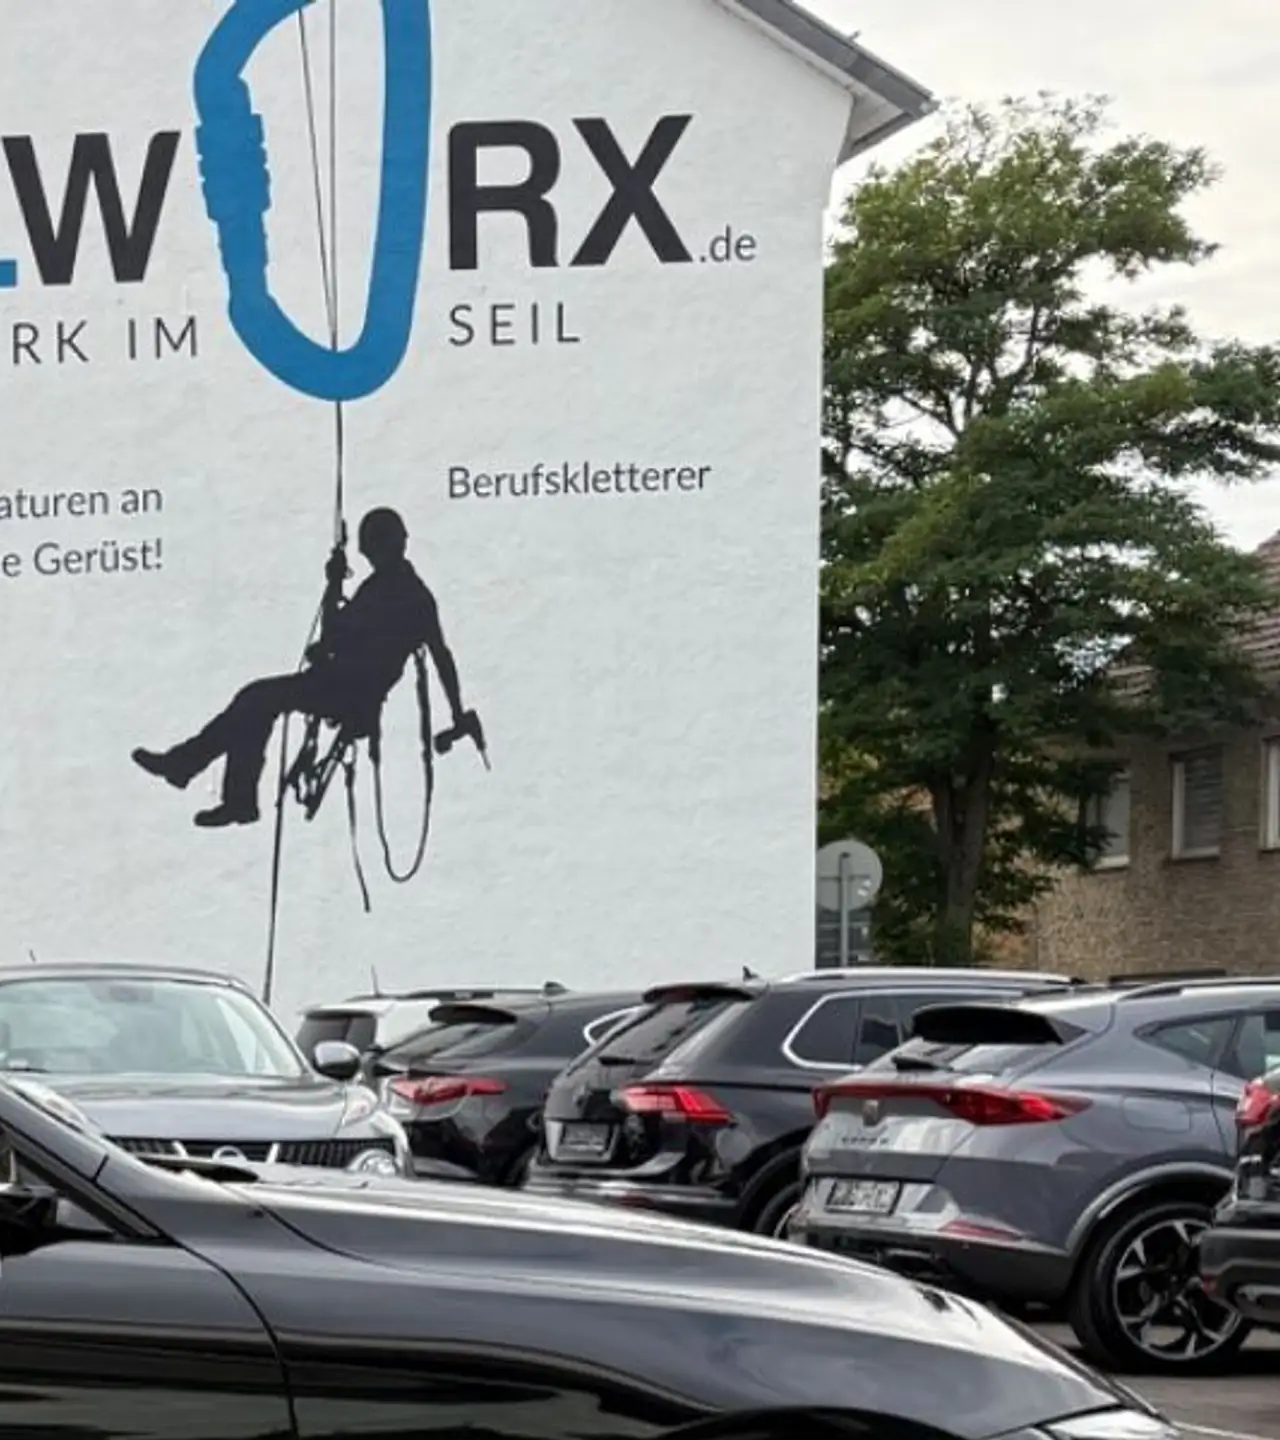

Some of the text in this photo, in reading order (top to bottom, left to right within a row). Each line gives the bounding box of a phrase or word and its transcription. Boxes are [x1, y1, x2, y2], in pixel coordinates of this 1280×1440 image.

[128, 316, 198, 360] IM
[448, 302, 581, 347] SEIL
[448, 460, 712, 500] Berufskletterer
[121, 488, 163, 514] an
[33, 538, 163, 576] Gerüst!
